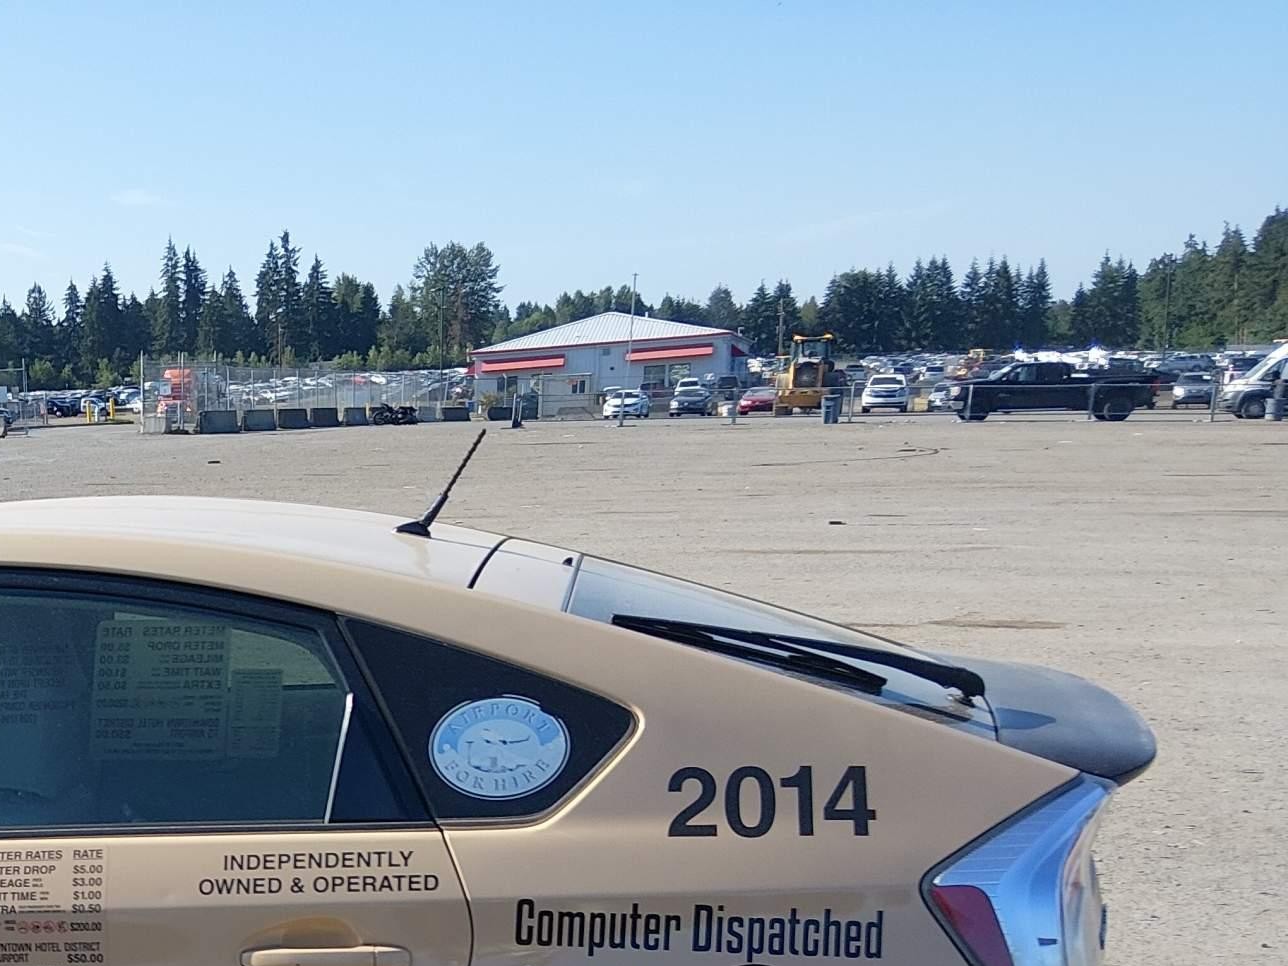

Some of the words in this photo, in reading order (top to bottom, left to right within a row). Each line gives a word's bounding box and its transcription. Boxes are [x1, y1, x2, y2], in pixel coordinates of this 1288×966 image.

[449, 703, 551, 735] AIRPORT
[444, 760, 485, 790] FOR
[493, 759, 551, 791] HIRE
[667, 765, 877, 838] 2014
[25, 850, 63, 860] RATES
[73, 849, 103, 859] RATE
[223, 850, 414, 871] INDEPENDENTLY
[24, 865, 56, 875] DROP
[72, 864, 103, 874] $5.00
[72, 877, 102, 887] $3.00
[199, 877, 282, 895] OWNED
[290, 877, 305, 893] &
[313, 875, 439, 893] OPERATED
[11, 891, 37, 901] TIME
[73, 890, 102, 900] $1.00
[72, 904, 102, 913] $0.50
[515, 898, 681, 957] Computer
[692, 904, 884, 963] Dispatched
[35, 943, 61, 952] HOTEL
[64, 942, 100, 952] DISTRICT
[67, 954, 104, 963] $50.00
